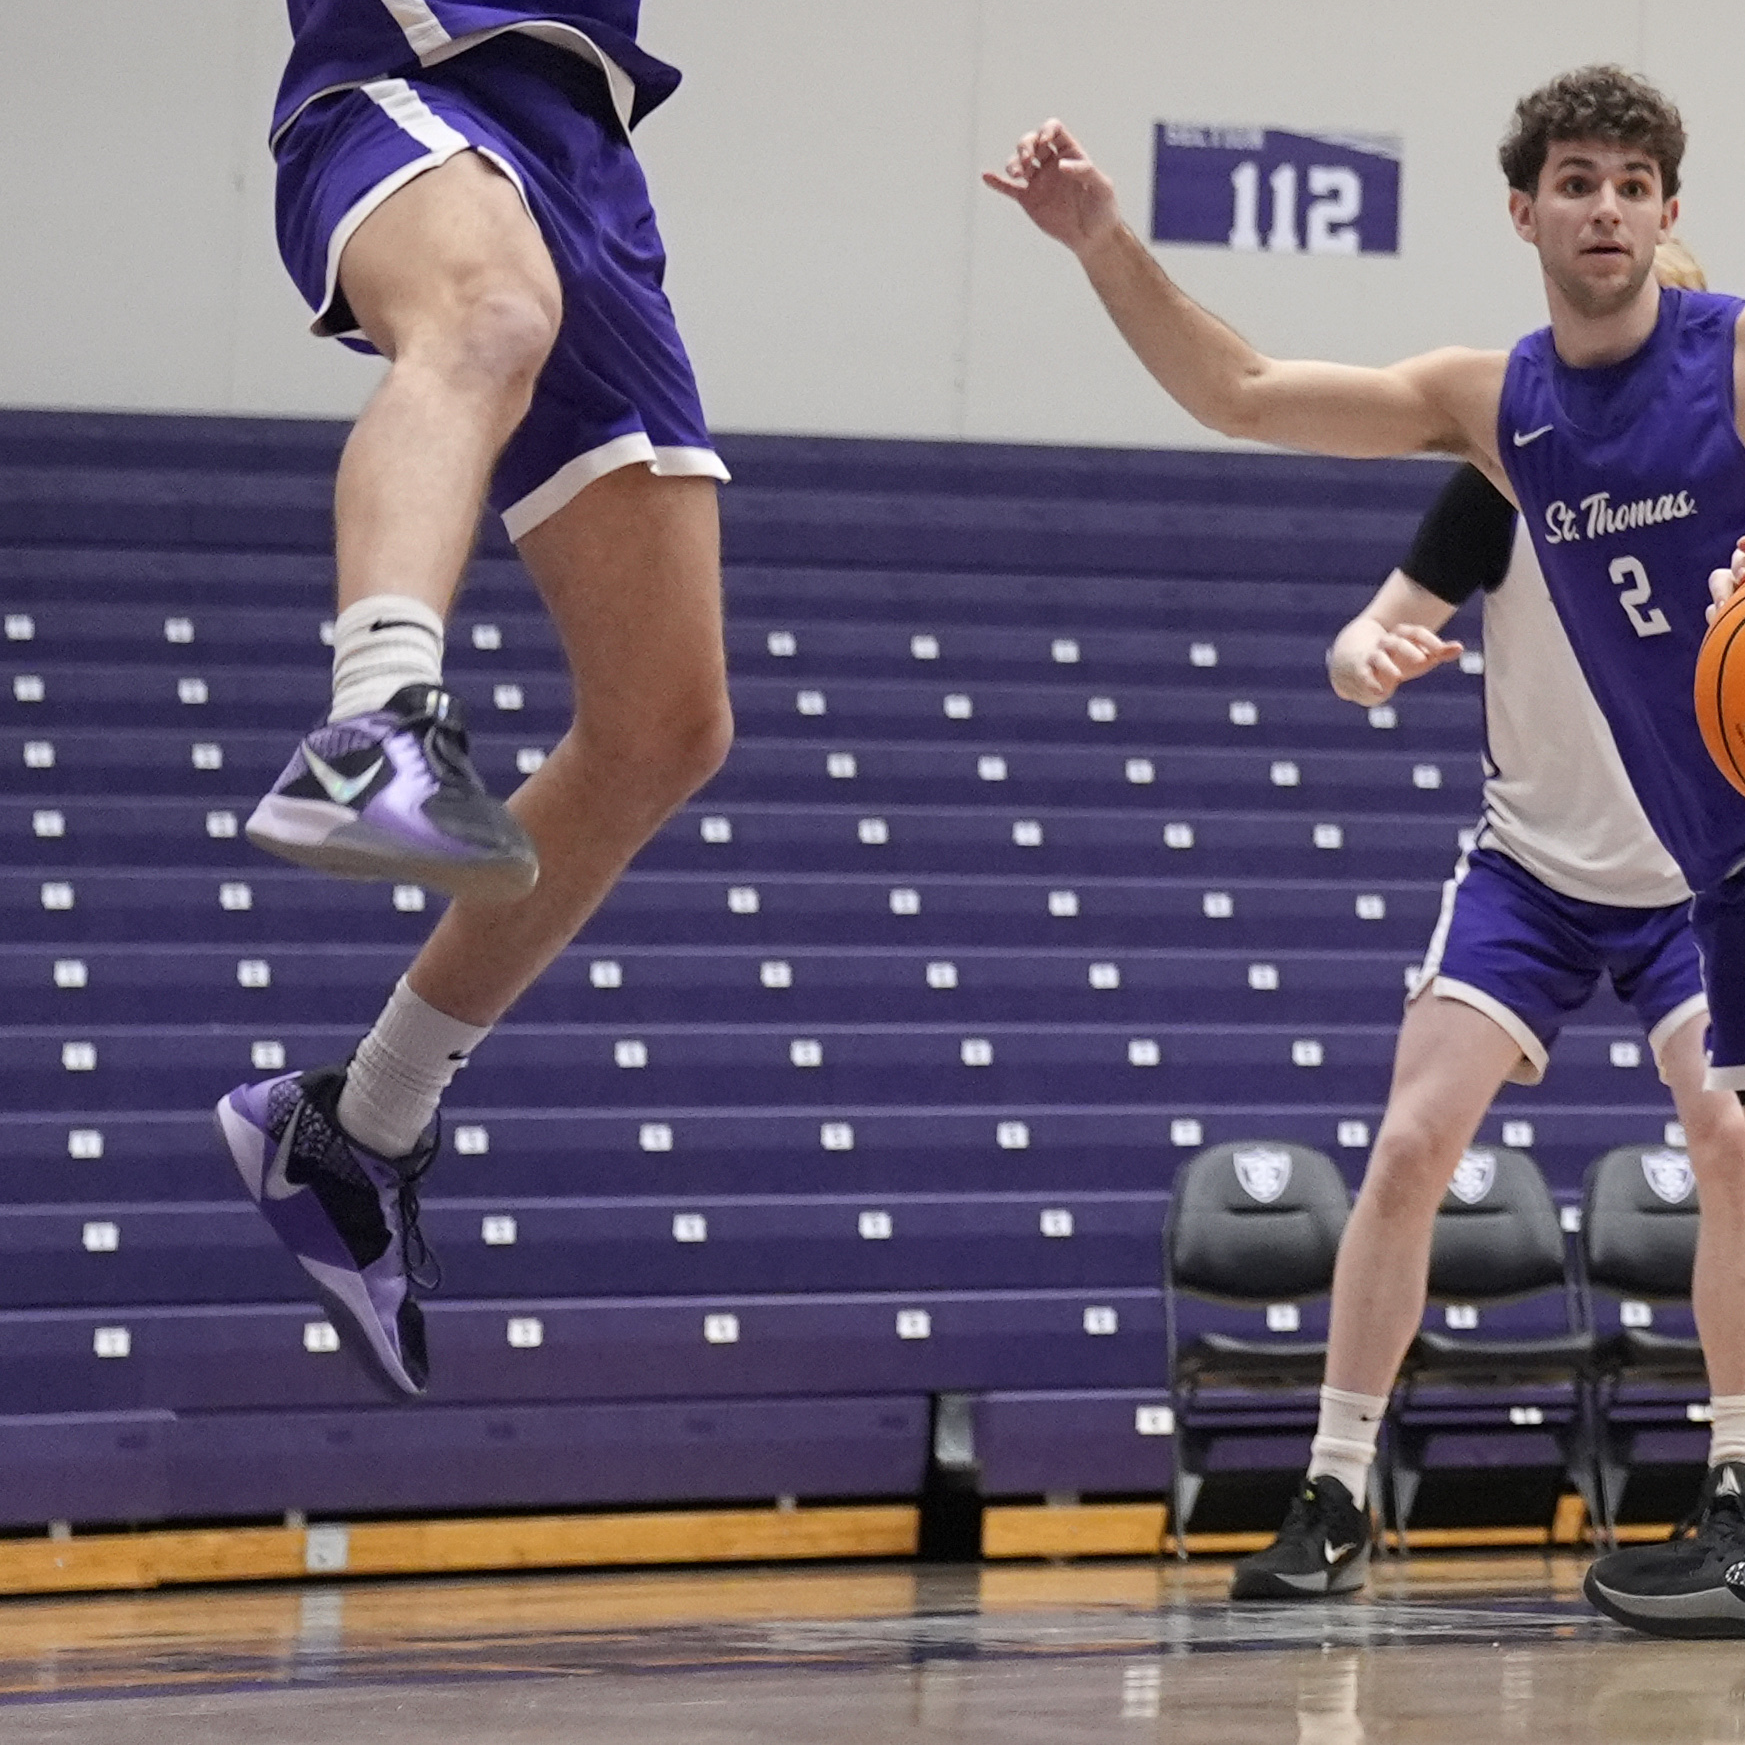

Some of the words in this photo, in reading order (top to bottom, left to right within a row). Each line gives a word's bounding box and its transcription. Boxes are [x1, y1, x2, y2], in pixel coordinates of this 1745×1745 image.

[1229, 160, 1363, 254] 112
[1545, 501, 1580, 544] St.
[1580, 490, 1695, 540] Thomas
[1608, 554, 1672, 637] 2
